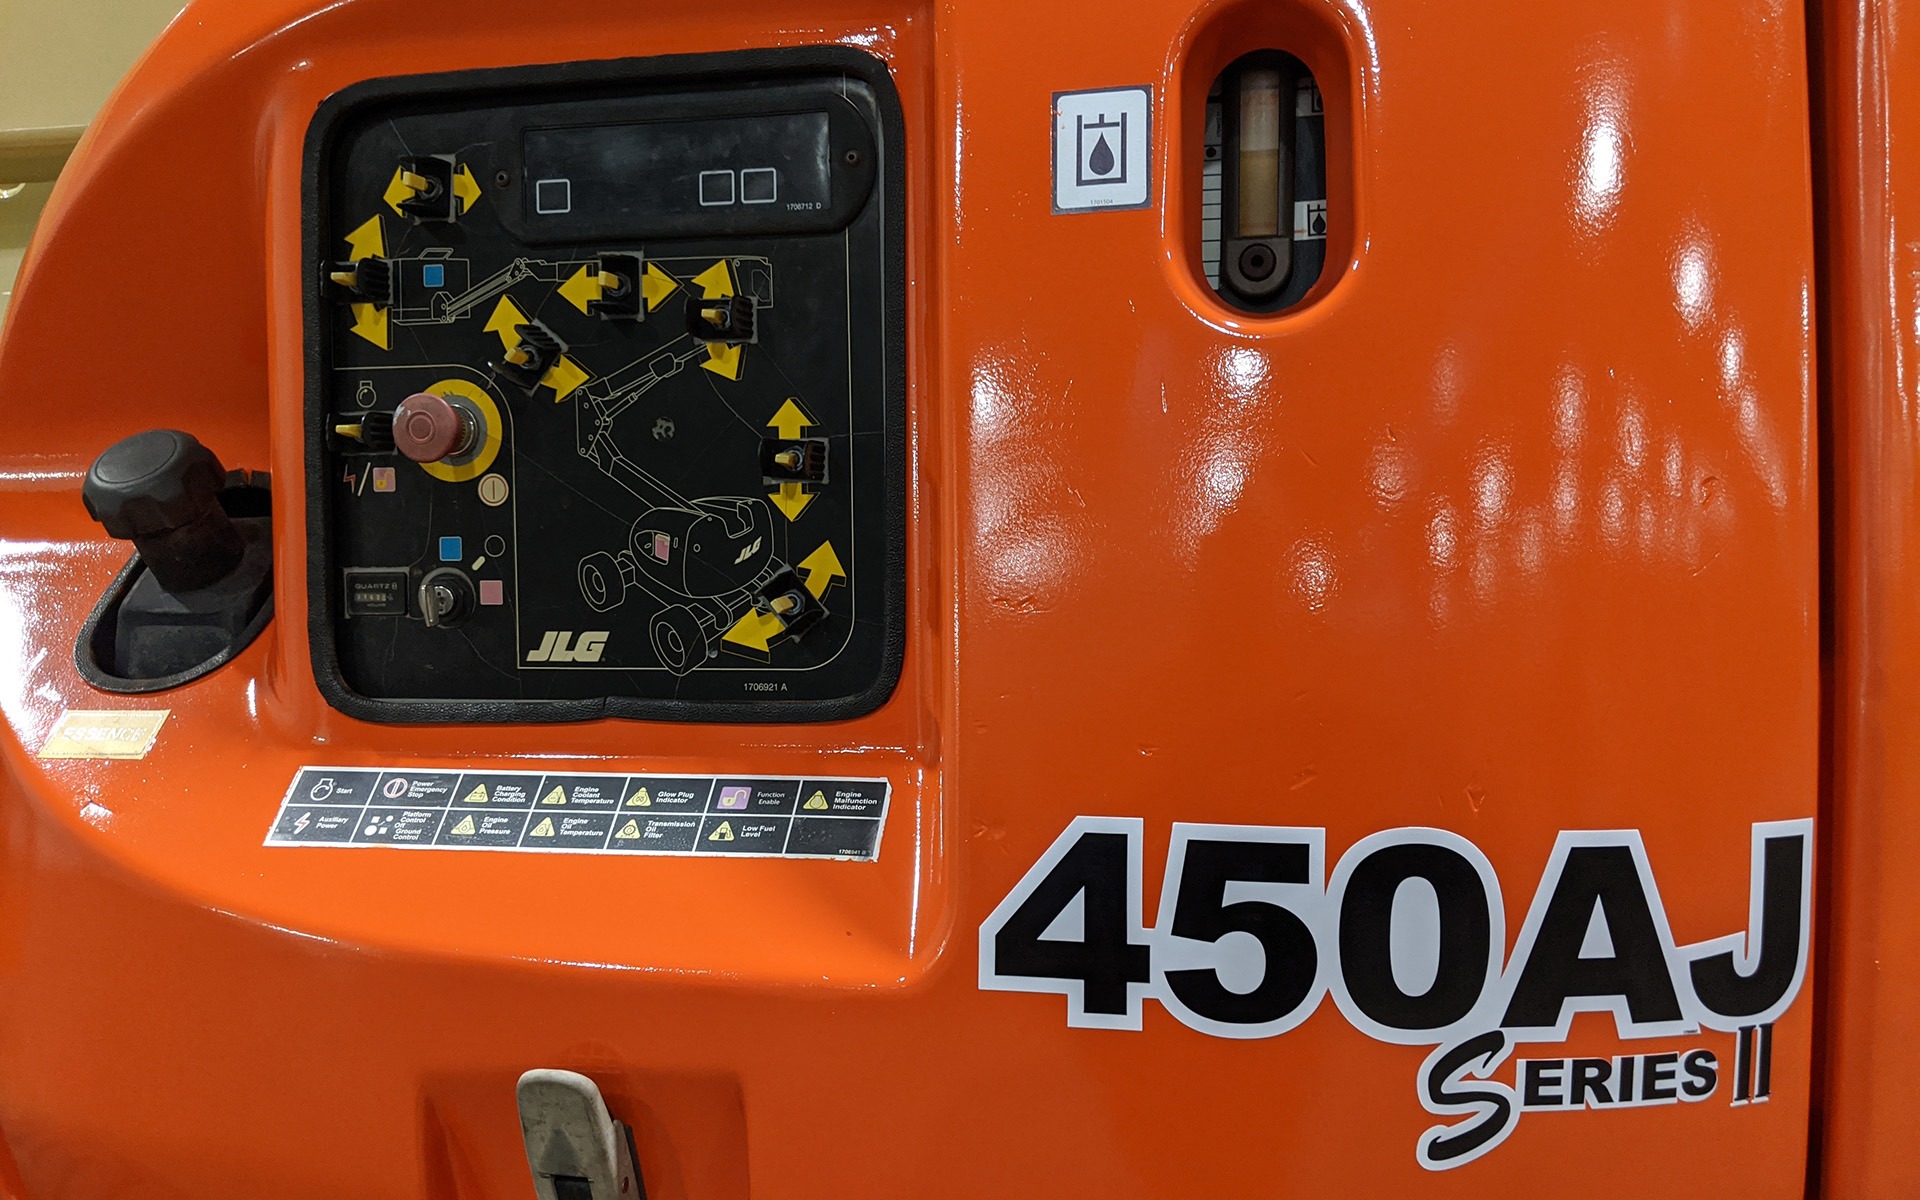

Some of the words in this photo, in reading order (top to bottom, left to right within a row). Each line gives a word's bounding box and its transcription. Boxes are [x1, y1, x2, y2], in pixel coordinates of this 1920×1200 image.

[734, 536, 762, 564] JLG
[526, 631, 610, 662] JLG
[744, 682, 778, 691] 1706921
[780, 682, 788, 691] A
[994, 833, 1804, 1030] 450AJ
[1427, 1030, 1717, 1161] SERIES
